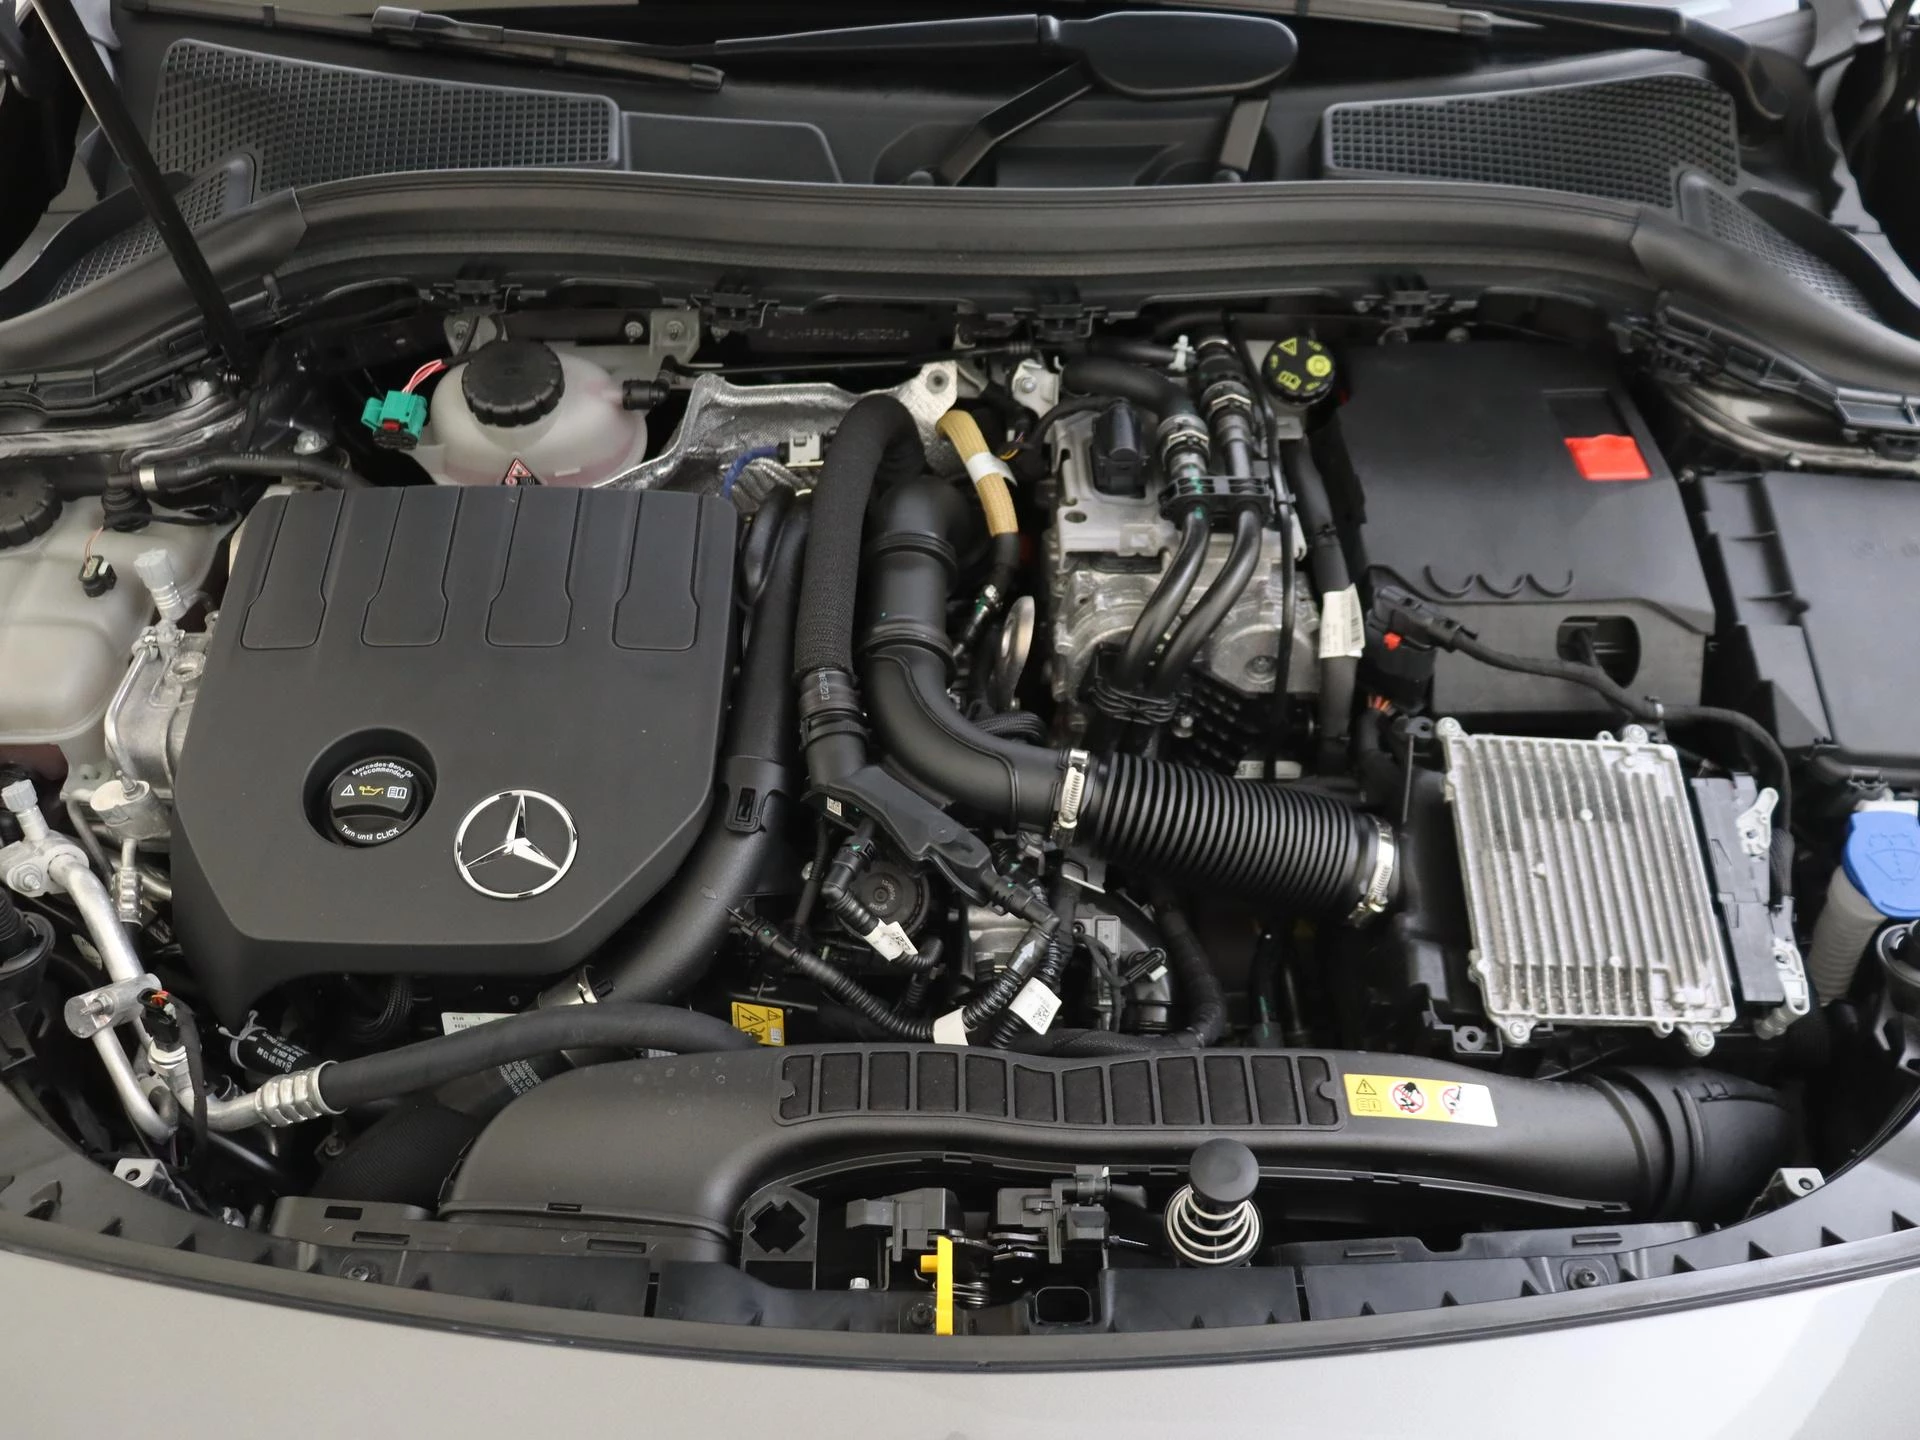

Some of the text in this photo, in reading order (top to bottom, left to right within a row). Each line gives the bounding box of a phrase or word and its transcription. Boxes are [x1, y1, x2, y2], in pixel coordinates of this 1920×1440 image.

[352, 762, 405, 775] Mercedes-Benz
[360, 767, 406, 779] recommended
[341, 824, 399, 841] Turn until CLICK
